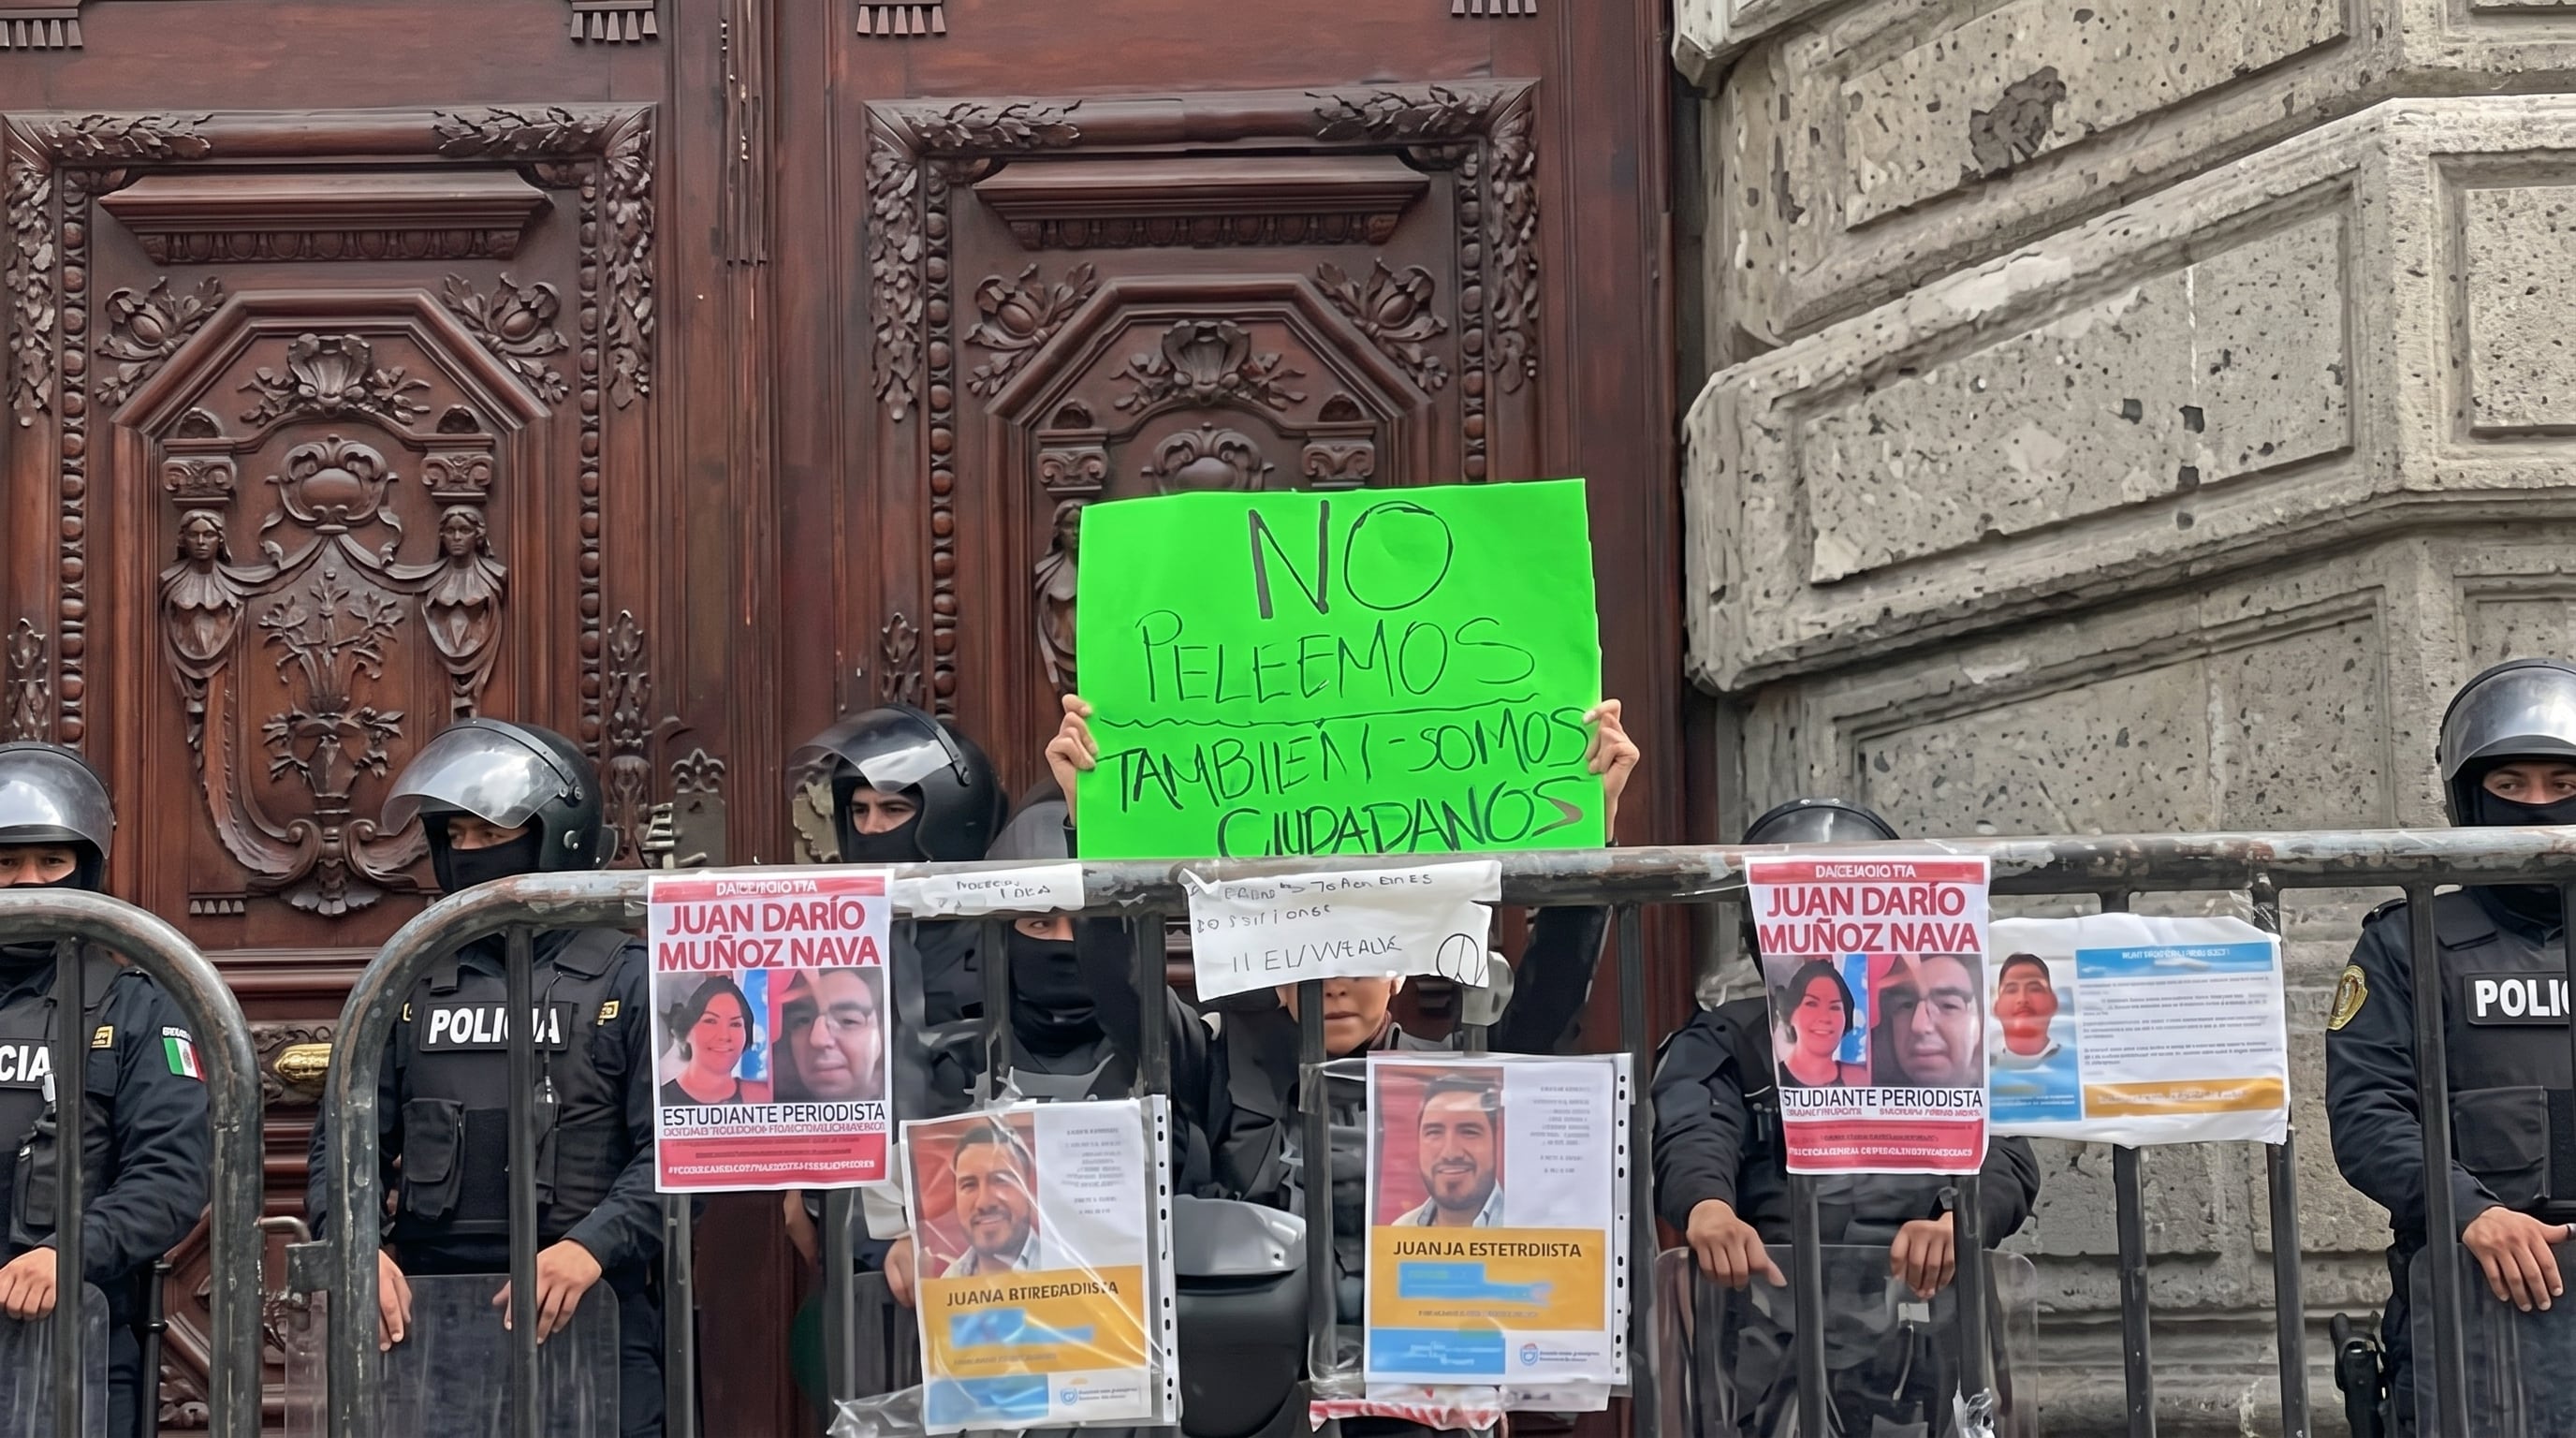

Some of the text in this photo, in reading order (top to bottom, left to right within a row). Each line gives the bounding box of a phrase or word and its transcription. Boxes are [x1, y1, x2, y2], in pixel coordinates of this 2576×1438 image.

[1249, 499, 1454, 620] NO
[1134, 609, 1536, 703] PELEEMOS
[666, 895, 866, 936] JUAN DARÍO
[1767, 881, 1967, 917] JUAN DARÍO
[658, 934, 881, 971] MUÑOZ NAVA
[1760, 917, 1982, 953] MUÑOZ NAVA
[2474, 978, 2570, 1018] POLI
[662, 1103, 886, 1126] ESTUDIANTE PERIODISTA
[1779, 1089, 1877, 1107] STUDIANTE
[1881, 1089, 1983, 1108] PERIODISTA
[946, 1288, 1004, 1307] JUANA
